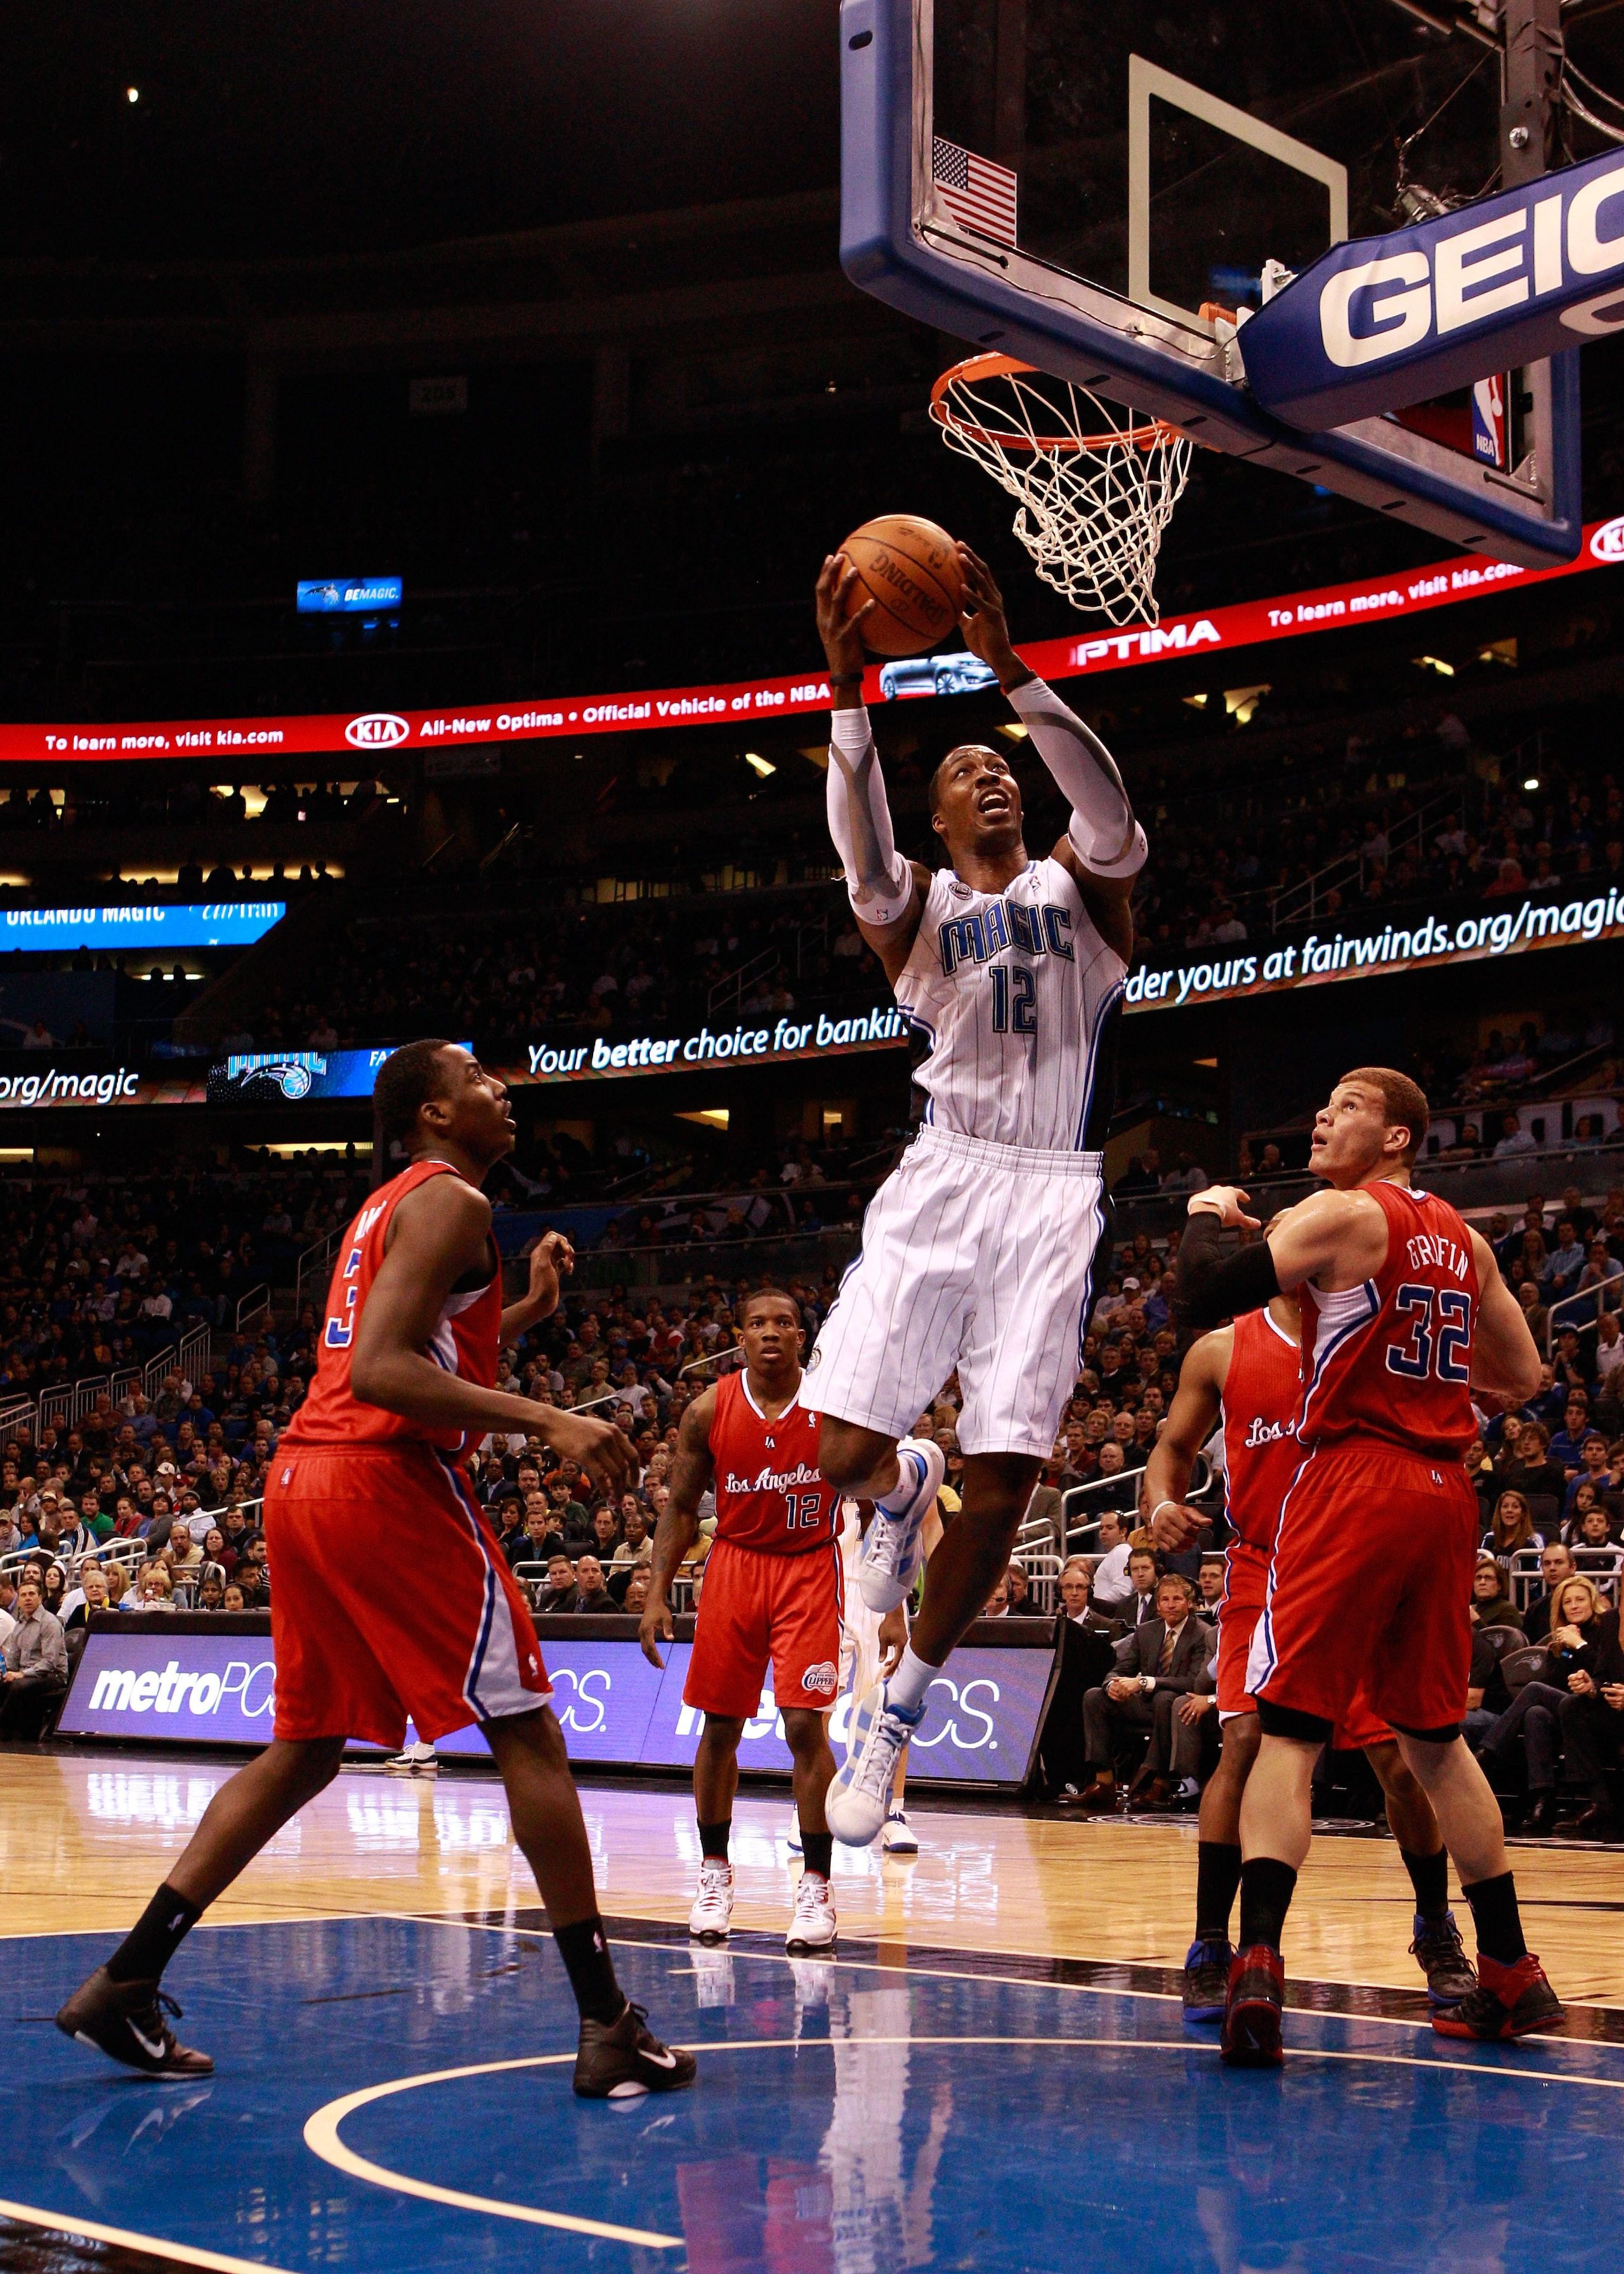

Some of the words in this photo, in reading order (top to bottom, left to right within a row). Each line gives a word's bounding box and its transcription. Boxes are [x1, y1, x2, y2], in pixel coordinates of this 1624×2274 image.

[1476, 433, 1495, 457] NBA
[1268, 609, 1293, 626] To
[1297, 600, 1346, 622] learn
[1350, 589, 1405, 612] more,
[1408, 575, 1448, 600] visit
[1067, 619, 1221, 666] PTIMA
[419, 718, 491, 737] All-New
[496, 711, 563, 732] Optima
[582, 702, 651, 723] Official
[656, 696, 726, 717] Vehicle
[731, 692, 751, 711] of
[755, 690, 785, 707] the
[790, 683, 831, 703] NBA
[45, 735, 68, 751] To
[73, 735, 117, 751] learn
[121, 735, 170, 750] more,
[175, 731, 212, 747] visit
[216, 730, 284, 746] kia.com
[938, 899, 1075, 976] MAGIC
[1123, 964, 1174, 1003] der
[1175, 956, 1257, 1004] yours
[1262, 945, 1297, 980] at
[988, 965, 1037, 1034] 12
[528, 1044, 588, 1074] Your
[591, 1038, 679, 1069] better
[683, 1027, 769, 1061] choice
[773, 1017, 813, 1051] for
[1385, 1282, 1472, 1386] 32
[1245, 1417, 1283, 1447] Los
[724, 1473, 752, 1493] Los
[752, 1462, 822, 1494] Angeles
[785, 1493, 822, 1529] 12
